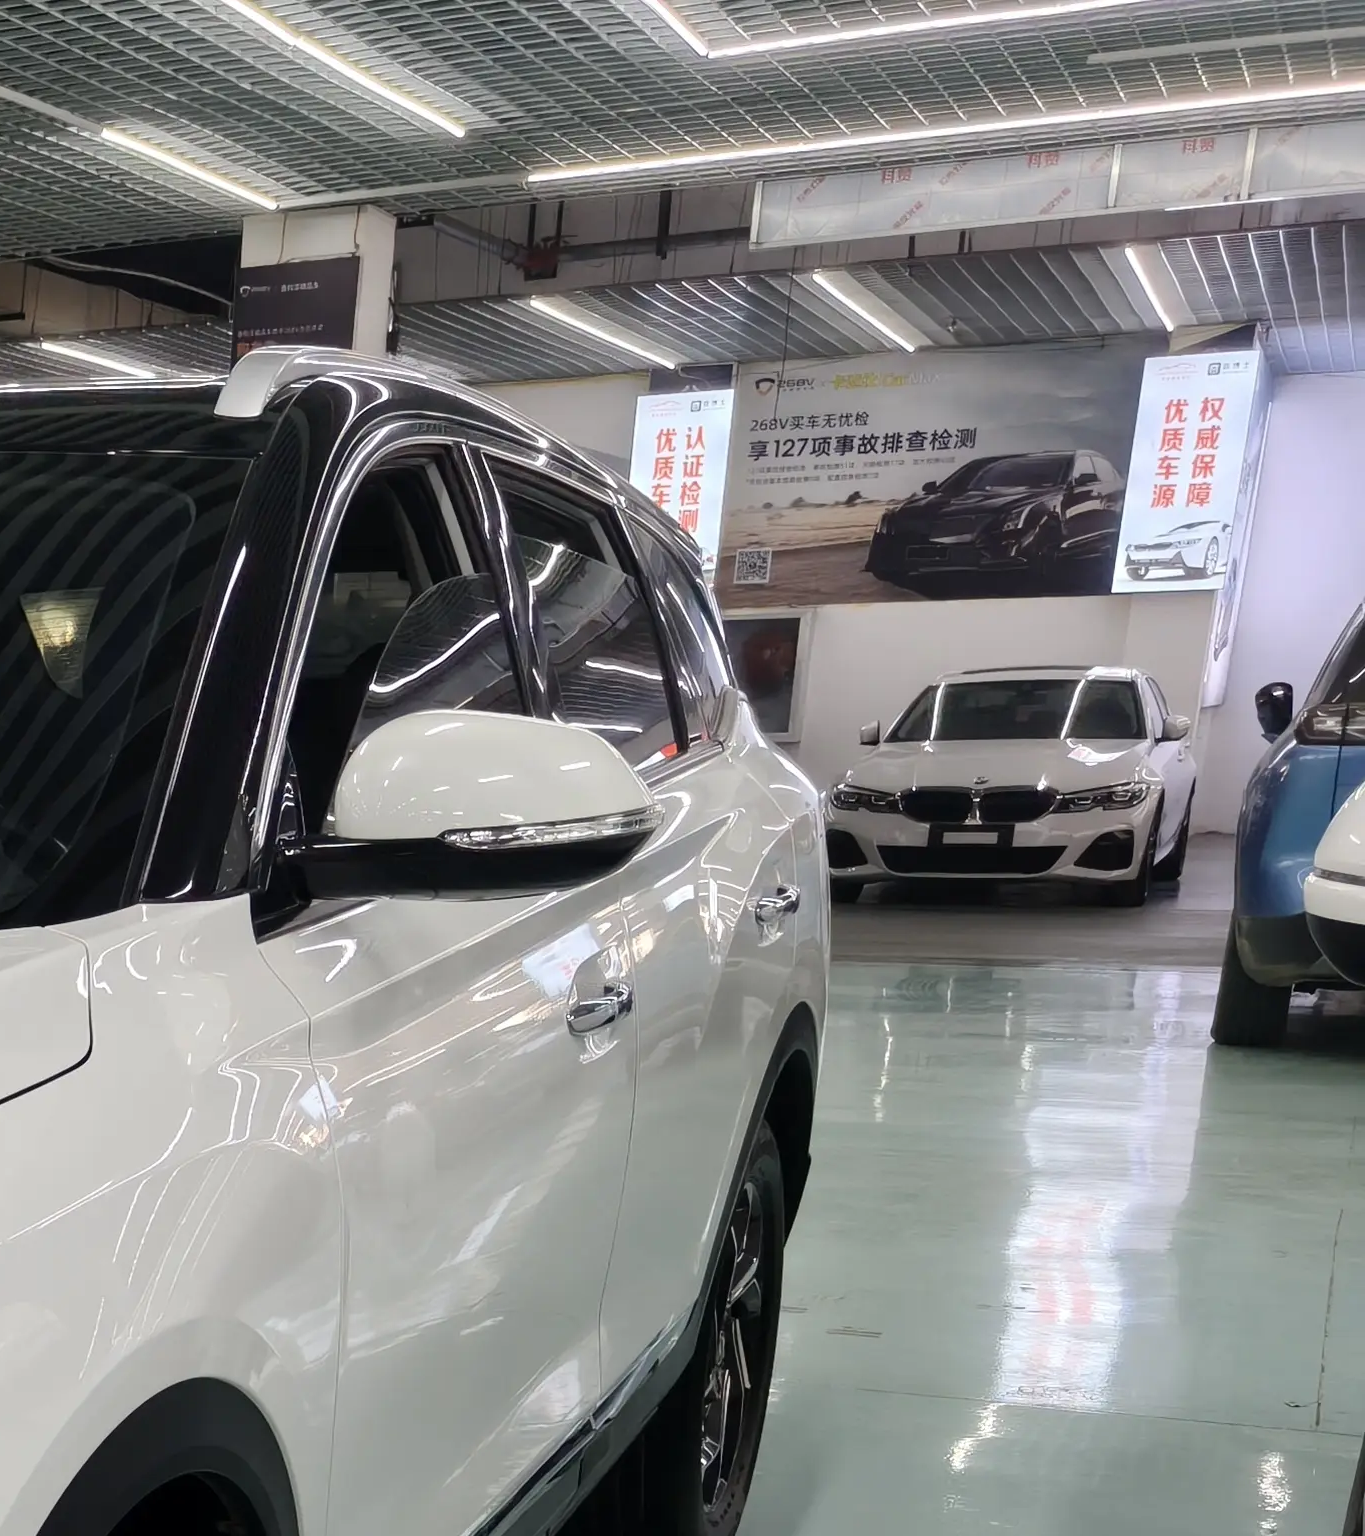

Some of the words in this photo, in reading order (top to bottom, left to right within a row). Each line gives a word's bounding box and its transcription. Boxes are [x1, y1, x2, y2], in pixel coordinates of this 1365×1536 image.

[678, 425, 706, 533] 认证检测
[747, 427, 978, 462] 享127项事故排查检测
[1150, 398, 1189, 509] 优质车源
[1185, 396, 1226, 508] 权威保障
